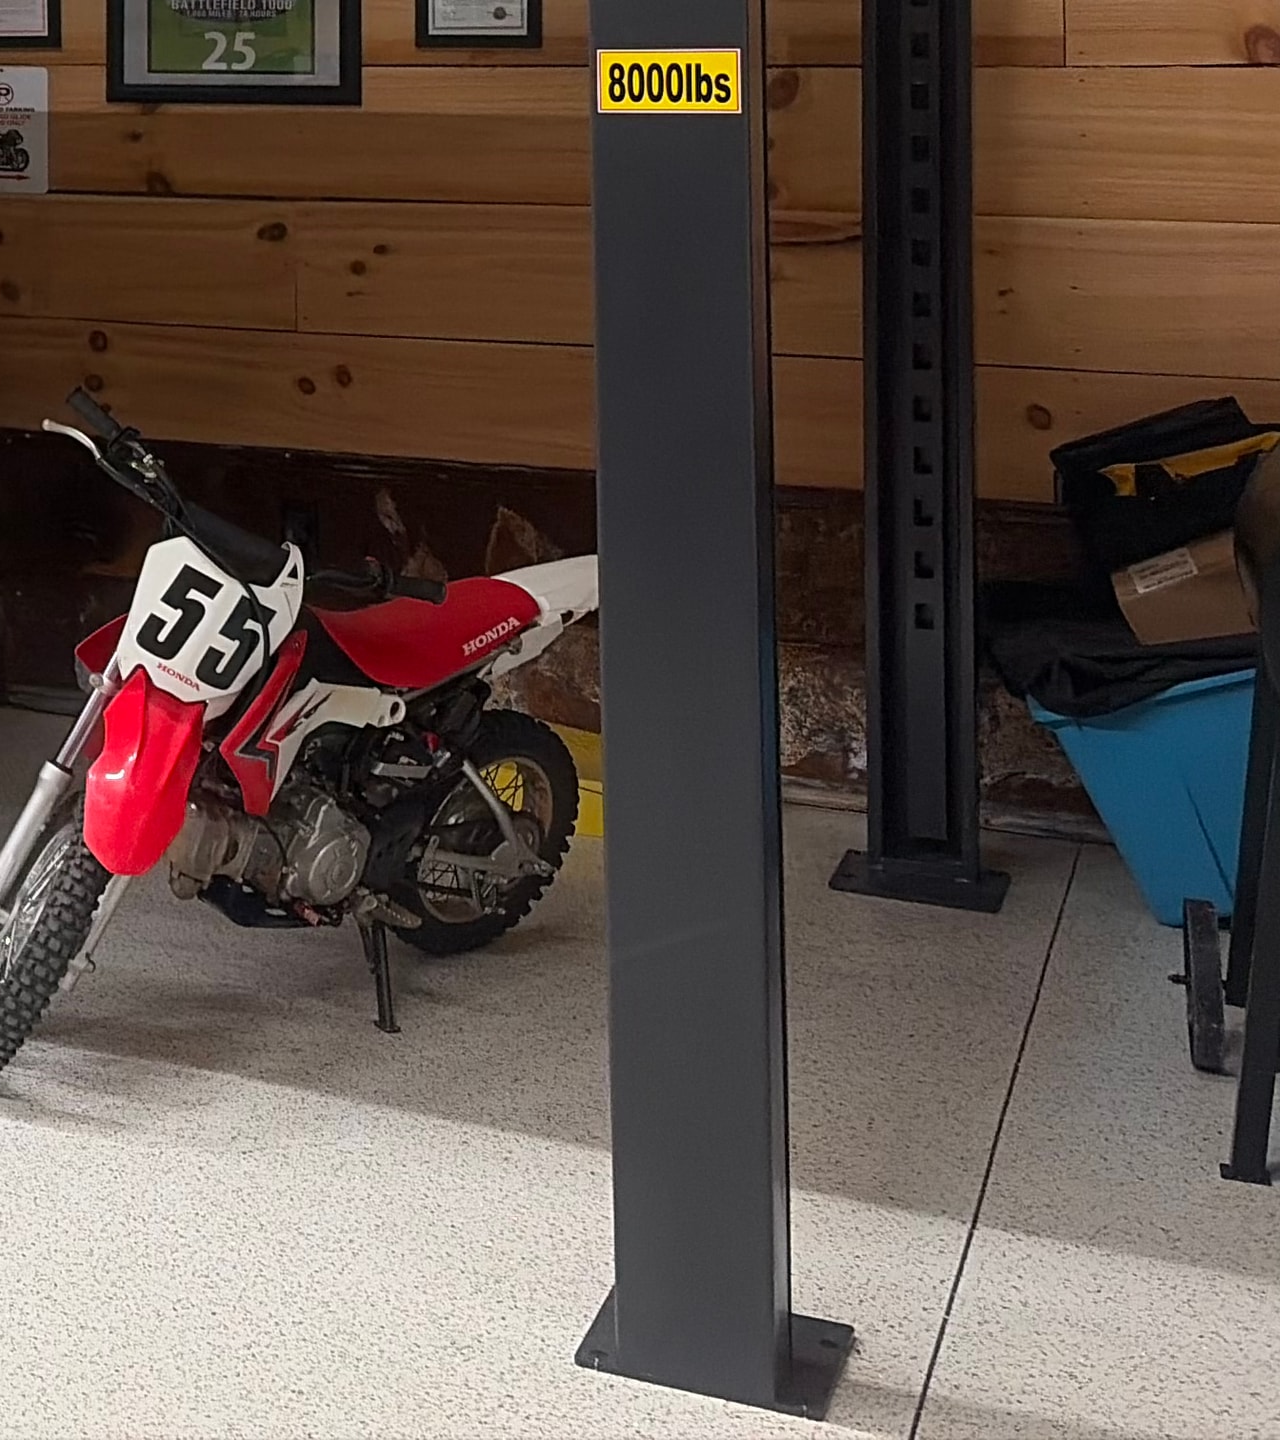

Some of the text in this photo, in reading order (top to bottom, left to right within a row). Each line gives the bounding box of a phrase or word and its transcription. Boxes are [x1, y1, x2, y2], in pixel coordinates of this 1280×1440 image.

[171, 0, 294, 10] BATTLEFIELD 1000
[202, 31, 256, 71] 25
[607, 62, 731, 105] 8000lbs
[135, 563, 278, 691] 55
[462, 616, 521, 657] HONDA
[156, 661, 201, 692] HONDA
